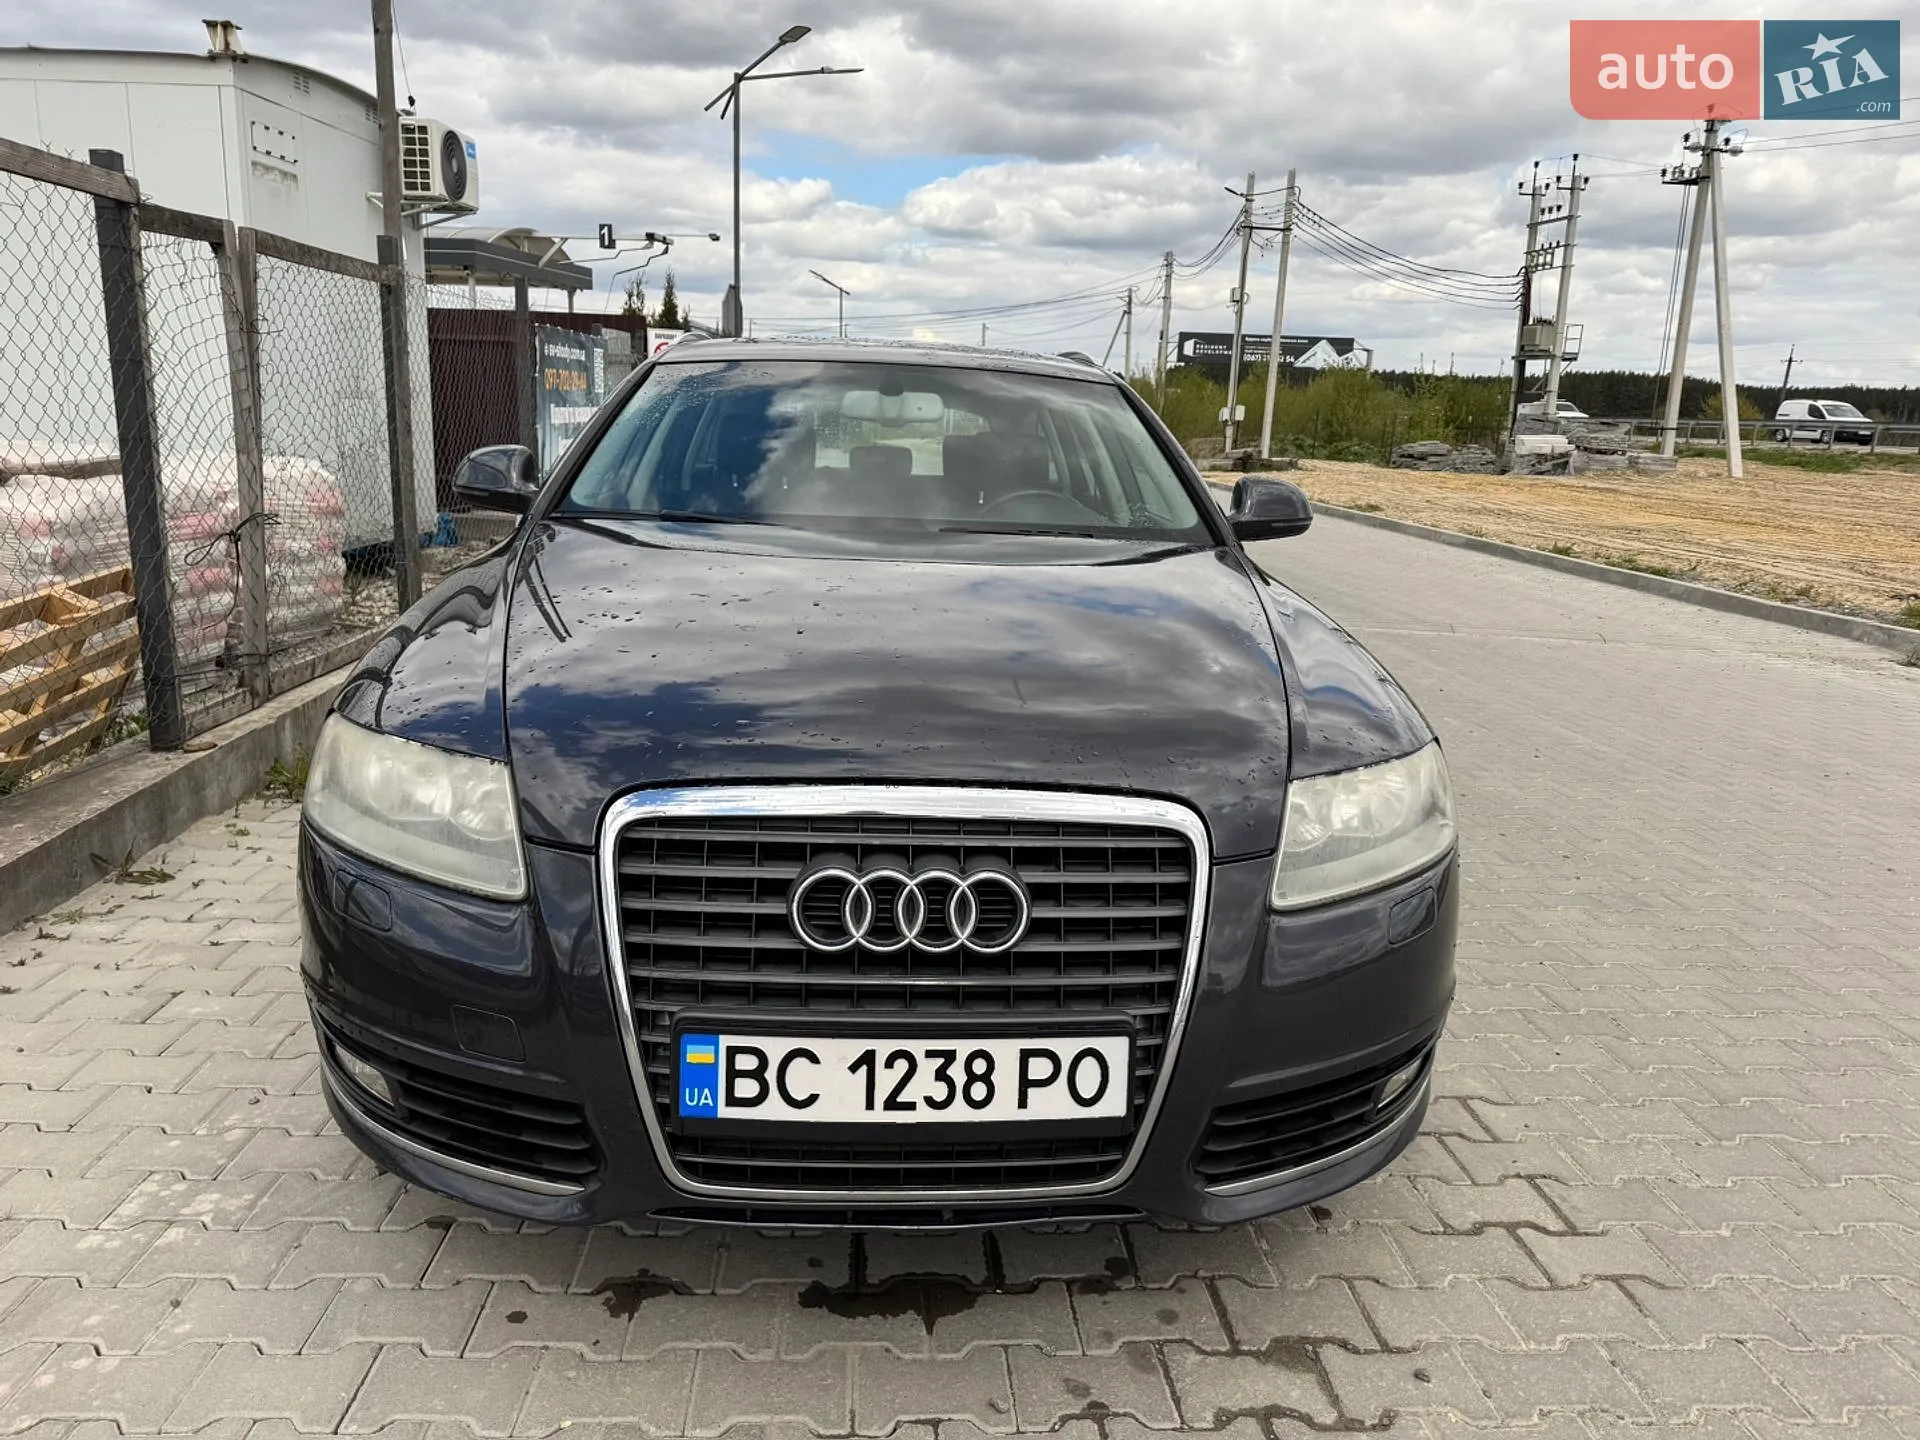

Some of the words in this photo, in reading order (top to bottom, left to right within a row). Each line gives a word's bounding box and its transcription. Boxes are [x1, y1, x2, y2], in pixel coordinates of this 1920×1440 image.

[600, 225, 609, 246] 1
[724, 1045, 821, 1109] BC
[846, 1048, 996, 1111] 1238
[1017, 1046, 1109, 1109] PO
[685, 1087, 713, 1106] UA
